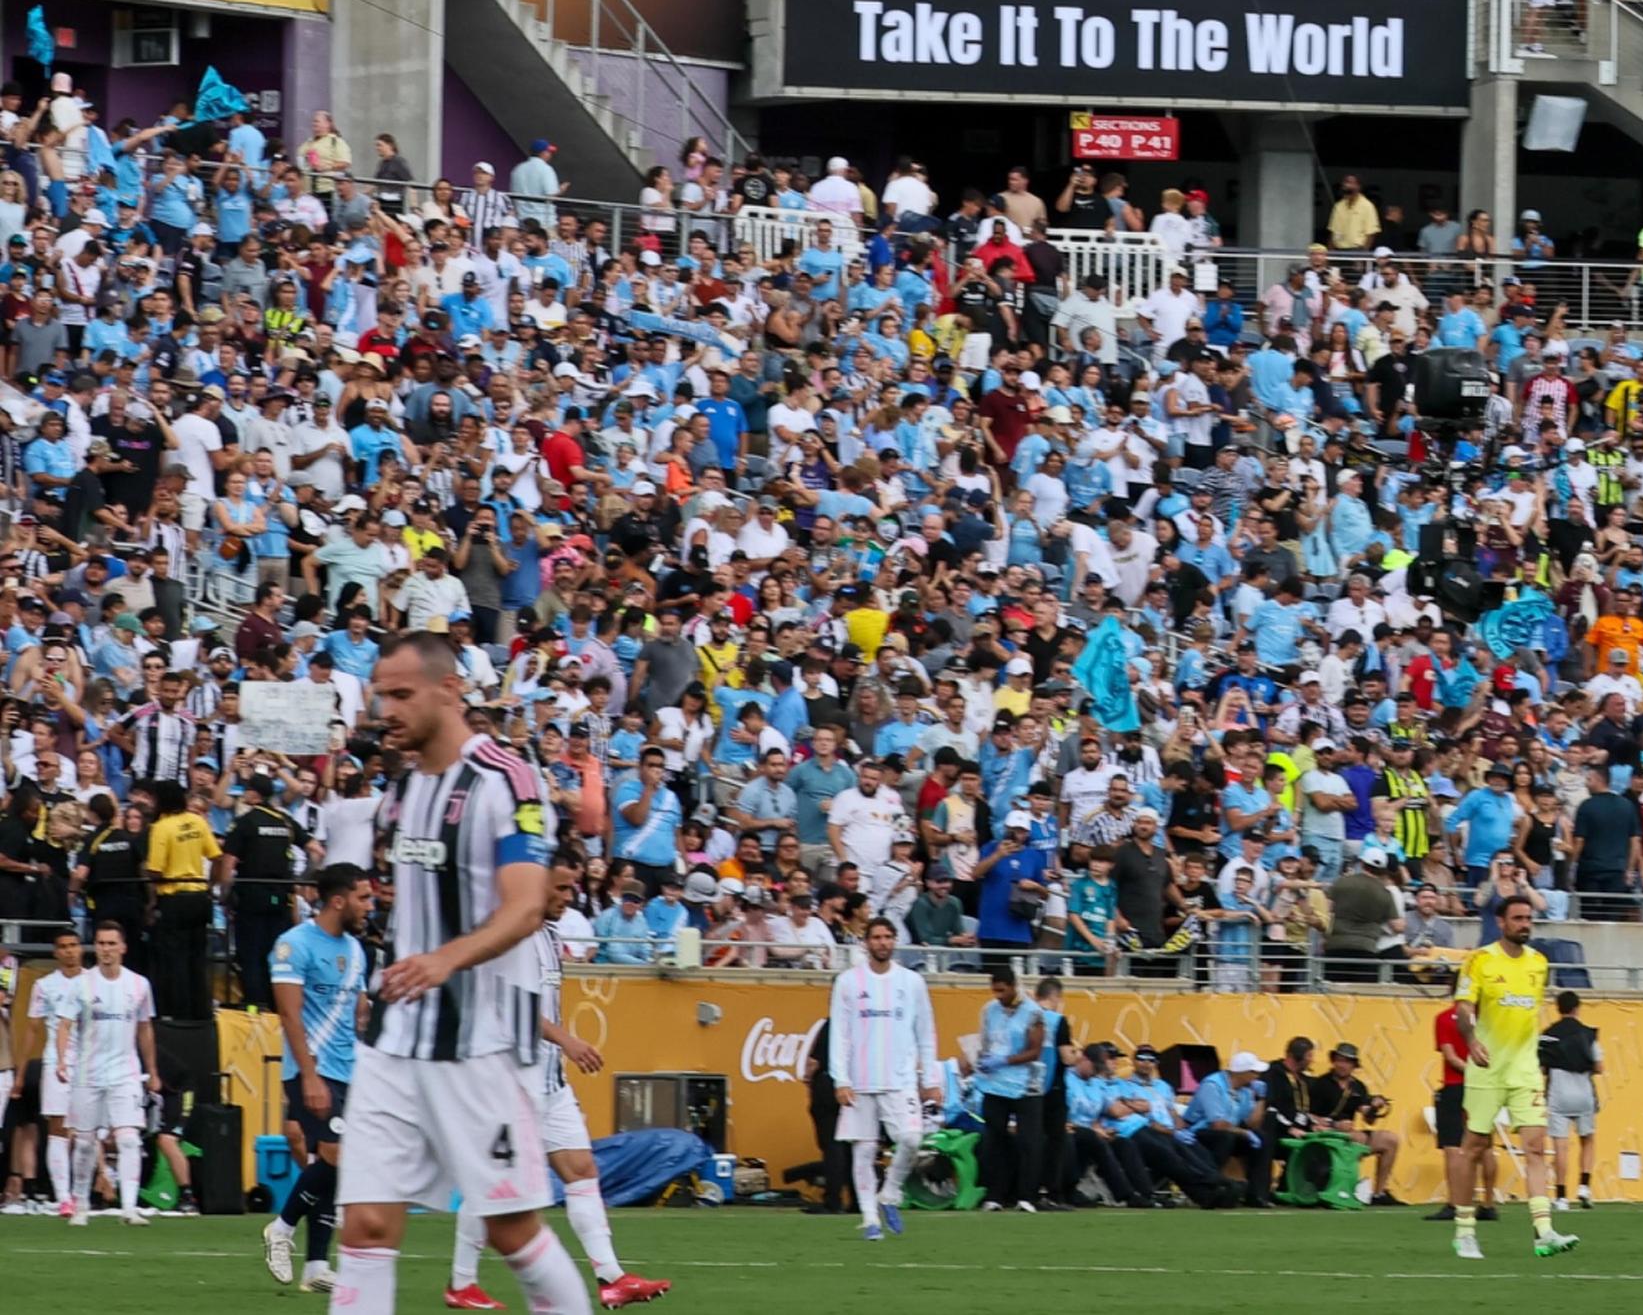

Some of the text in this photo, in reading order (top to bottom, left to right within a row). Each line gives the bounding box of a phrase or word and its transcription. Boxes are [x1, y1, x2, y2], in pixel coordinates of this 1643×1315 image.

[854, 0, 1404, 79] Take It To The World
[1092, 119, 1161, 132] SECTIONS
[491, 1124, 516, 1169] 4
